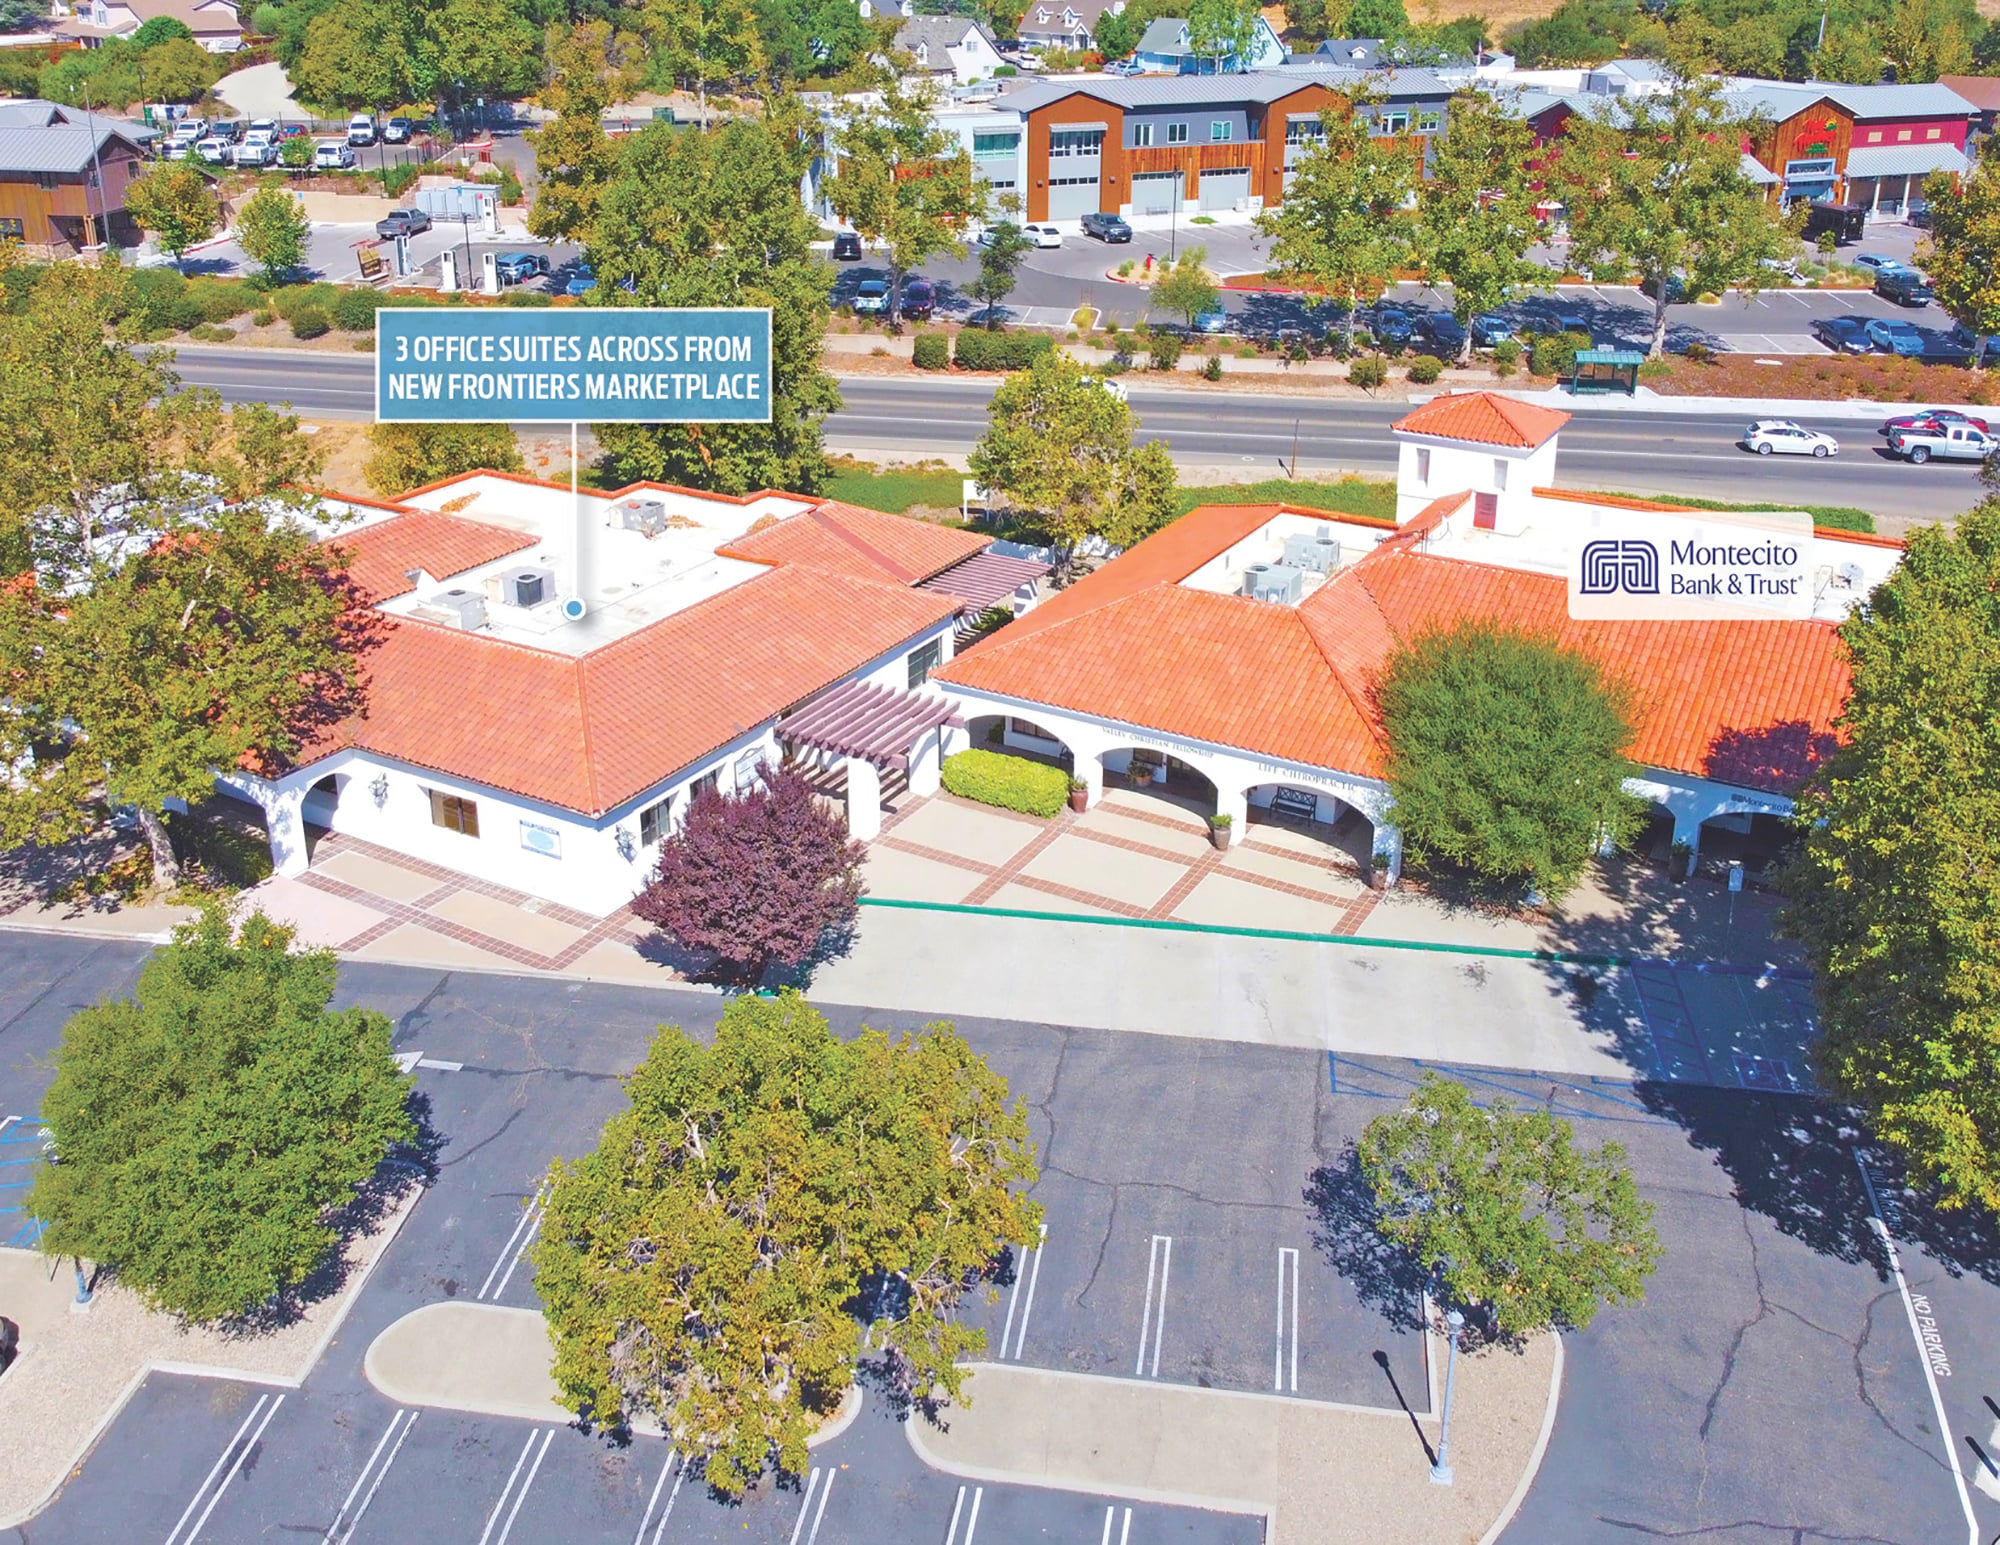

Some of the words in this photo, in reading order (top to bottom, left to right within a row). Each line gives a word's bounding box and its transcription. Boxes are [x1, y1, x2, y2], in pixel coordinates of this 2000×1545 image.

[1102, 727, 1126, 738] VALLEY
[1129, 734, 1169, 748] CHRISTIAN
[1282, 769, 1356, 792] CHIROPRACTIC
[1911, 1293, 1932, 1314] NO
[1918, 1316, 1952, 1376] PARKING
